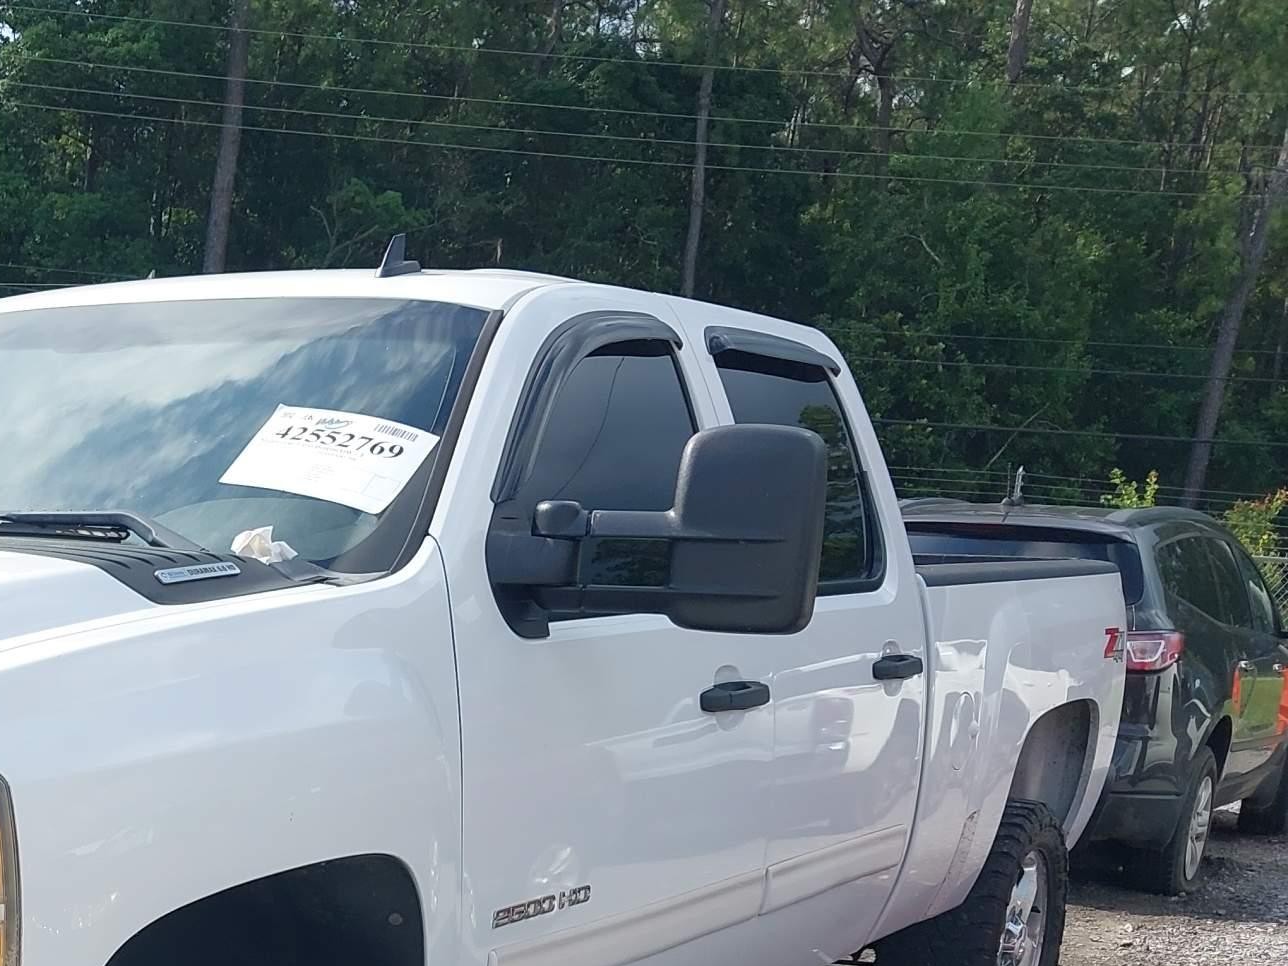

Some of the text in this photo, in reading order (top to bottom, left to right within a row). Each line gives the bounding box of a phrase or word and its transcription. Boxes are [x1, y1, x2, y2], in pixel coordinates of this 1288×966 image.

[275, 425, 404, 459] 42552769
[493, 885, 591, 929] 2500 HD
